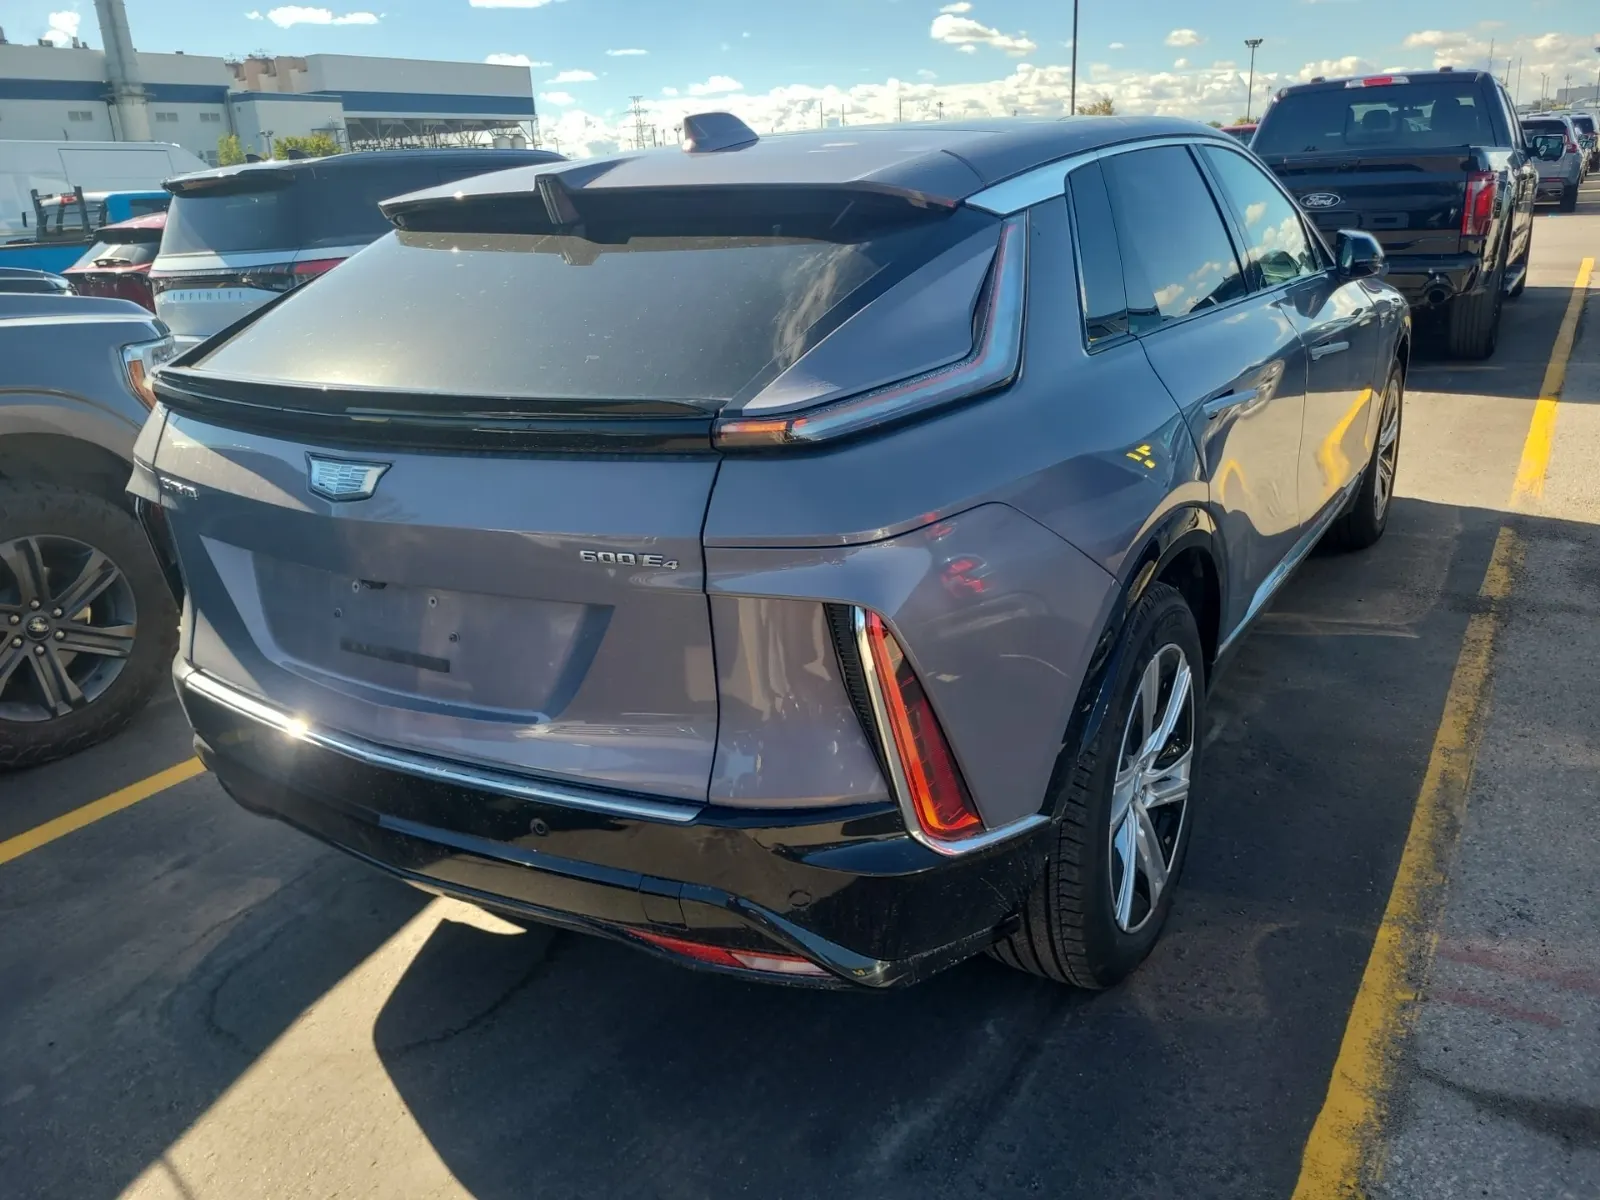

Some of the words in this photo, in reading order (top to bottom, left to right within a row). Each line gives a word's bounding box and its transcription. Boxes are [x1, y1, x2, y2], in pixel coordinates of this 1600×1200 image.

[1304, 194, 1334, 206] Ford
[172, 291, 242, 301] INFINITI
[579, 550, 637, 566] 600
